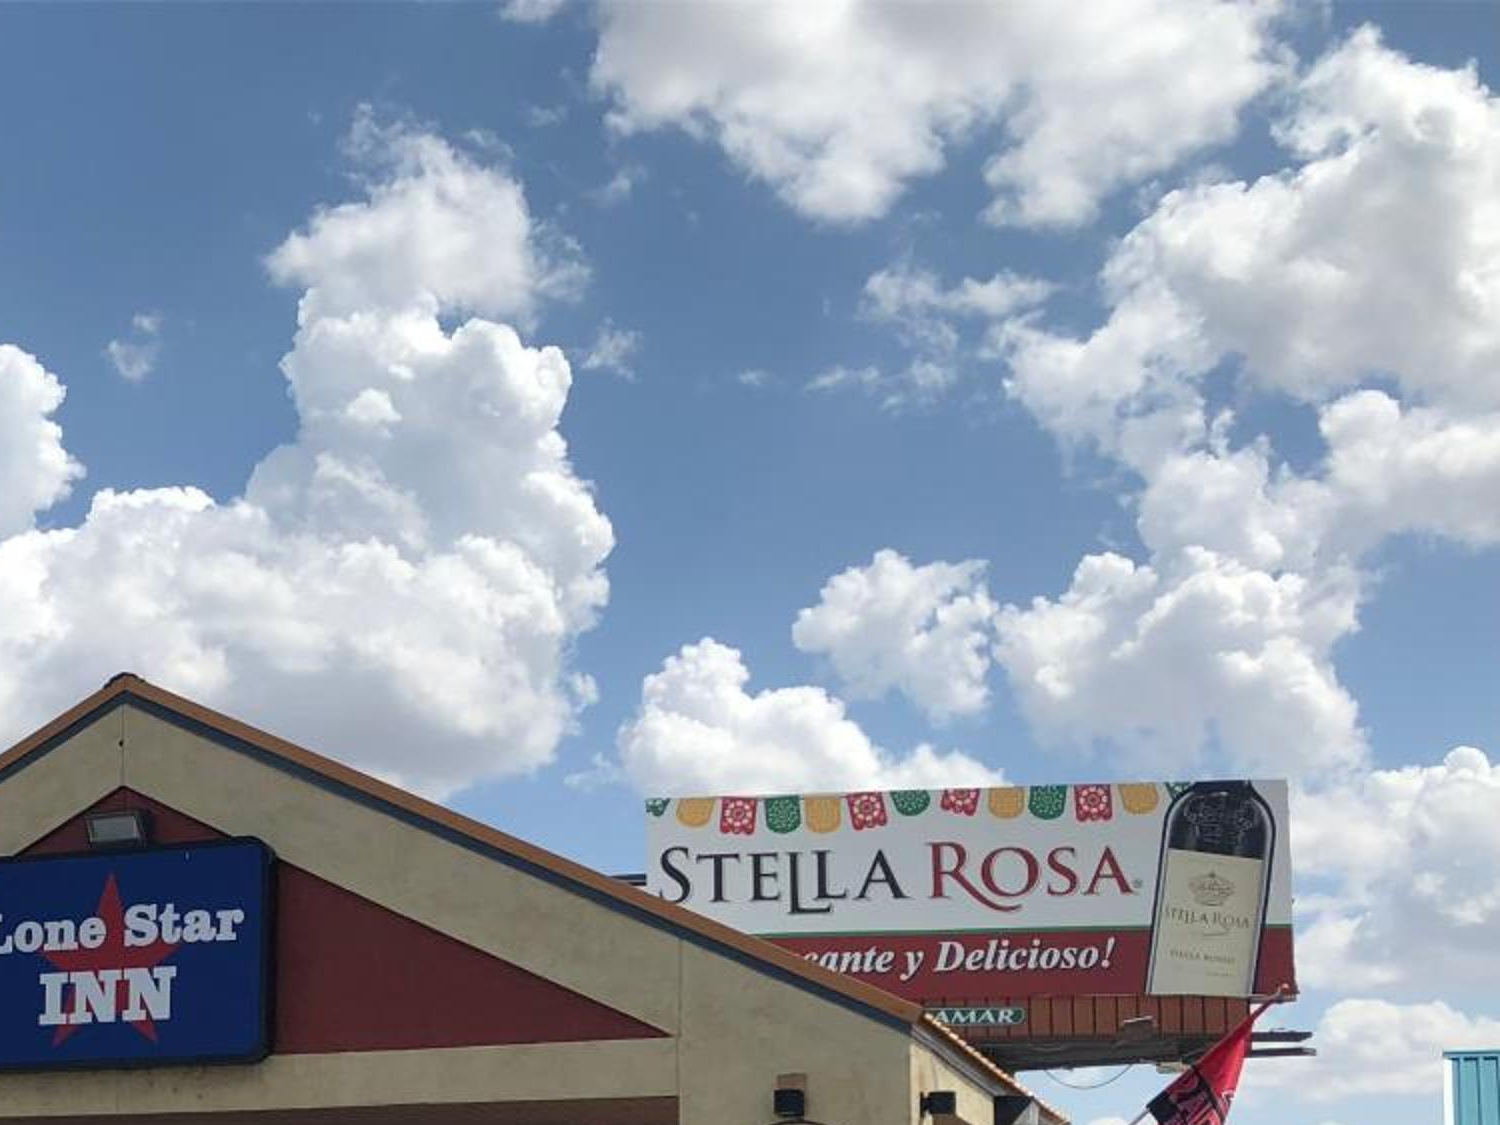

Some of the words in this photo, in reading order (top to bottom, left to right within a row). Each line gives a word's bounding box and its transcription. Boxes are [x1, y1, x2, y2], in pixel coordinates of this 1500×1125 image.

[660, 845, 911, 915] STELLA
[925, 841, 1135, 912] ROSA
[124, 903, 245, 947] Star
[900, 950, 924, 981] y
[933, 937, 1116, 973] Delicioso!
[38, 966, 177, 1026] INN
